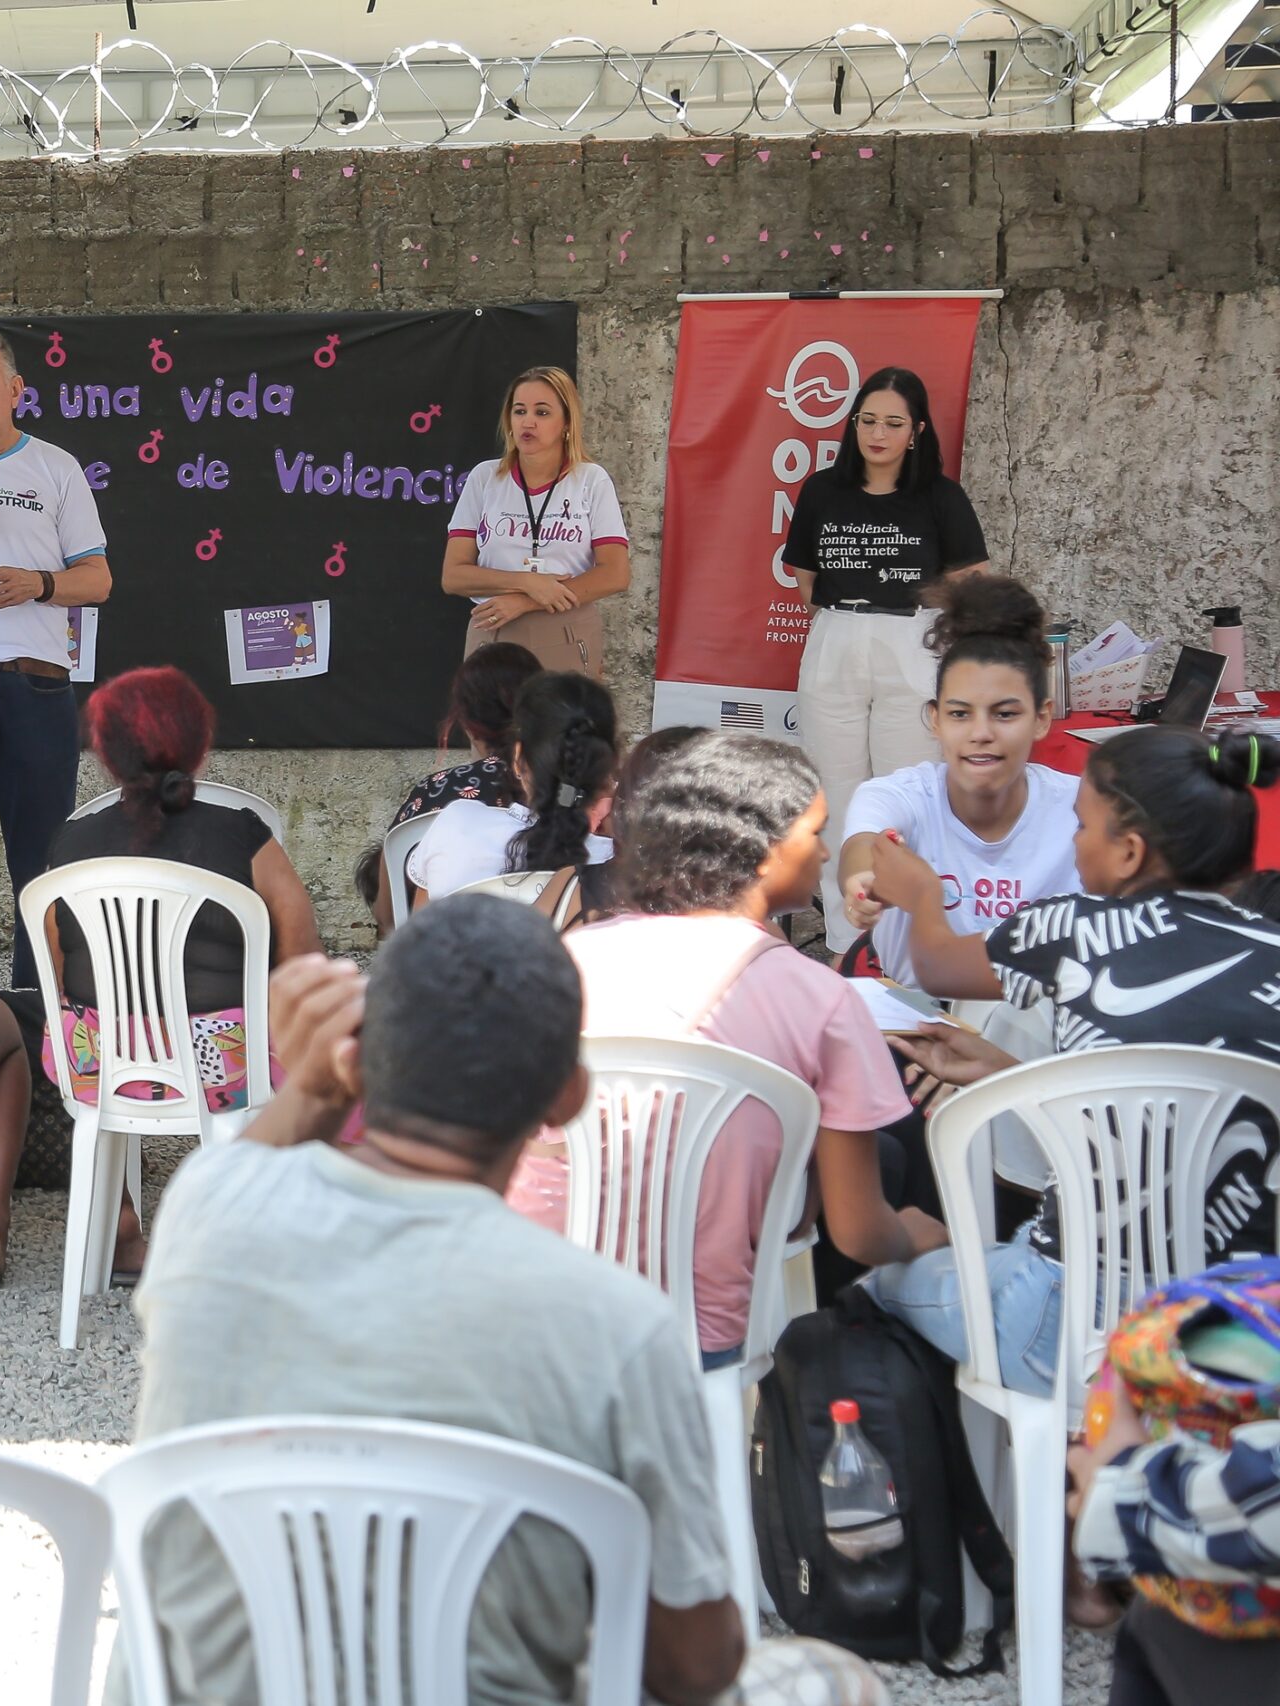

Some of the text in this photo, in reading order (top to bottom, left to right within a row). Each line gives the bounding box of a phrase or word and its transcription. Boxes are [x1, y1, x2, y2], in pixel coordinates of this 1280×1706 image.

[59, 383, 140, 418] una
[180, 372, 294, 422] vida
[177, 453, 230, 490] de
[495, 517, 583, 547] Mulher
[821, 522, 900, 534] Na violência
[819, 534, 921, 545] contra a mulher
[825, 547, 861, 558] gente
[864, 546, 899, 556] mete
[826, 557, 872, 569] colher.
[768, 600, 808, 614] ÁGUAS
[247, 609, 289, 621] AGOSTO
[766, 631, 808, 643] FRONT
[975, 879, 1021, 899] ORI
[1074, 896, 1178, 963] NIKE
